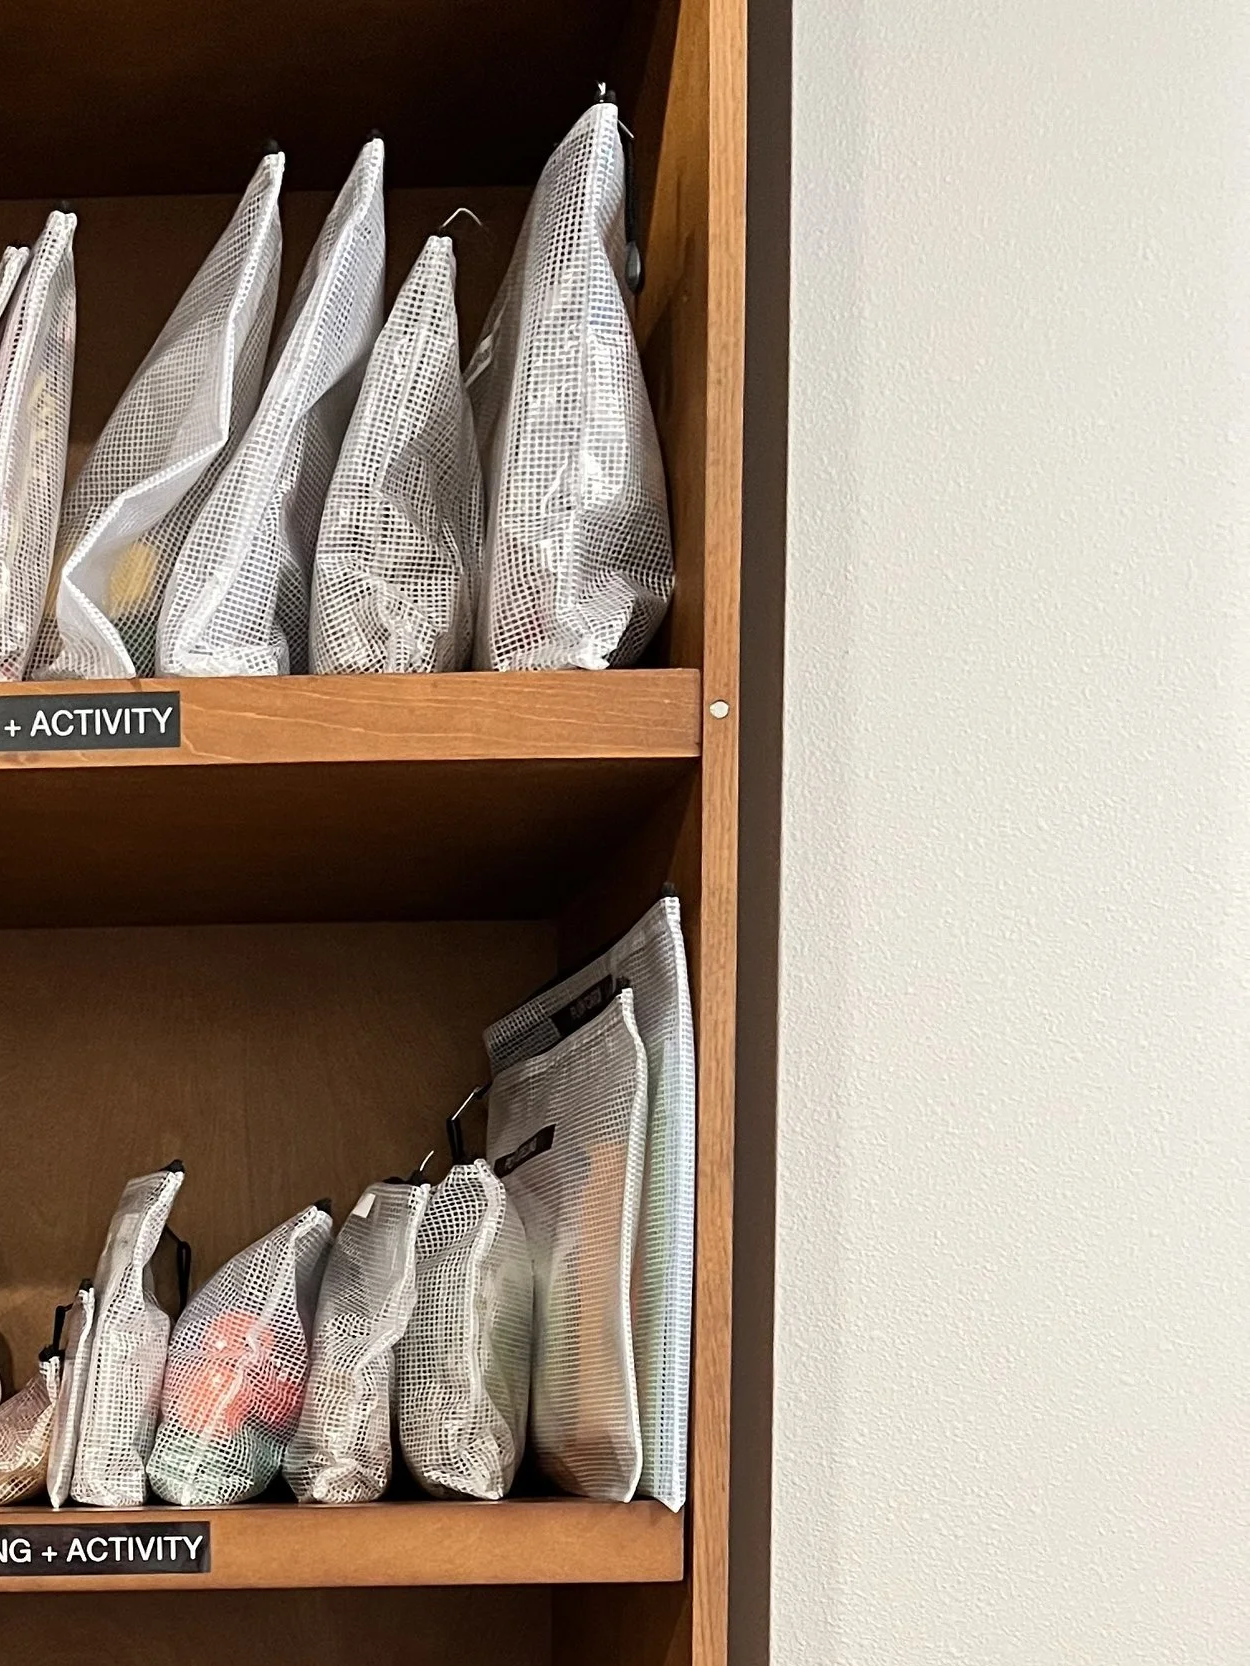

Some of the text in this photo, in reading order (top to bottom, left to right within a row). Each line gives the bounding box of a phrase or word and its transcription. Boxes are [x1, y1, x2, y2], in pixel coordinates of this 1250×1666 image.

[4, 719, 22, 738] +
[30, 706, 173, 737] ACTIVITY
[41, 1544, 58, 1563] +
[66, 1535, 203, 1563] ACTIVITY
